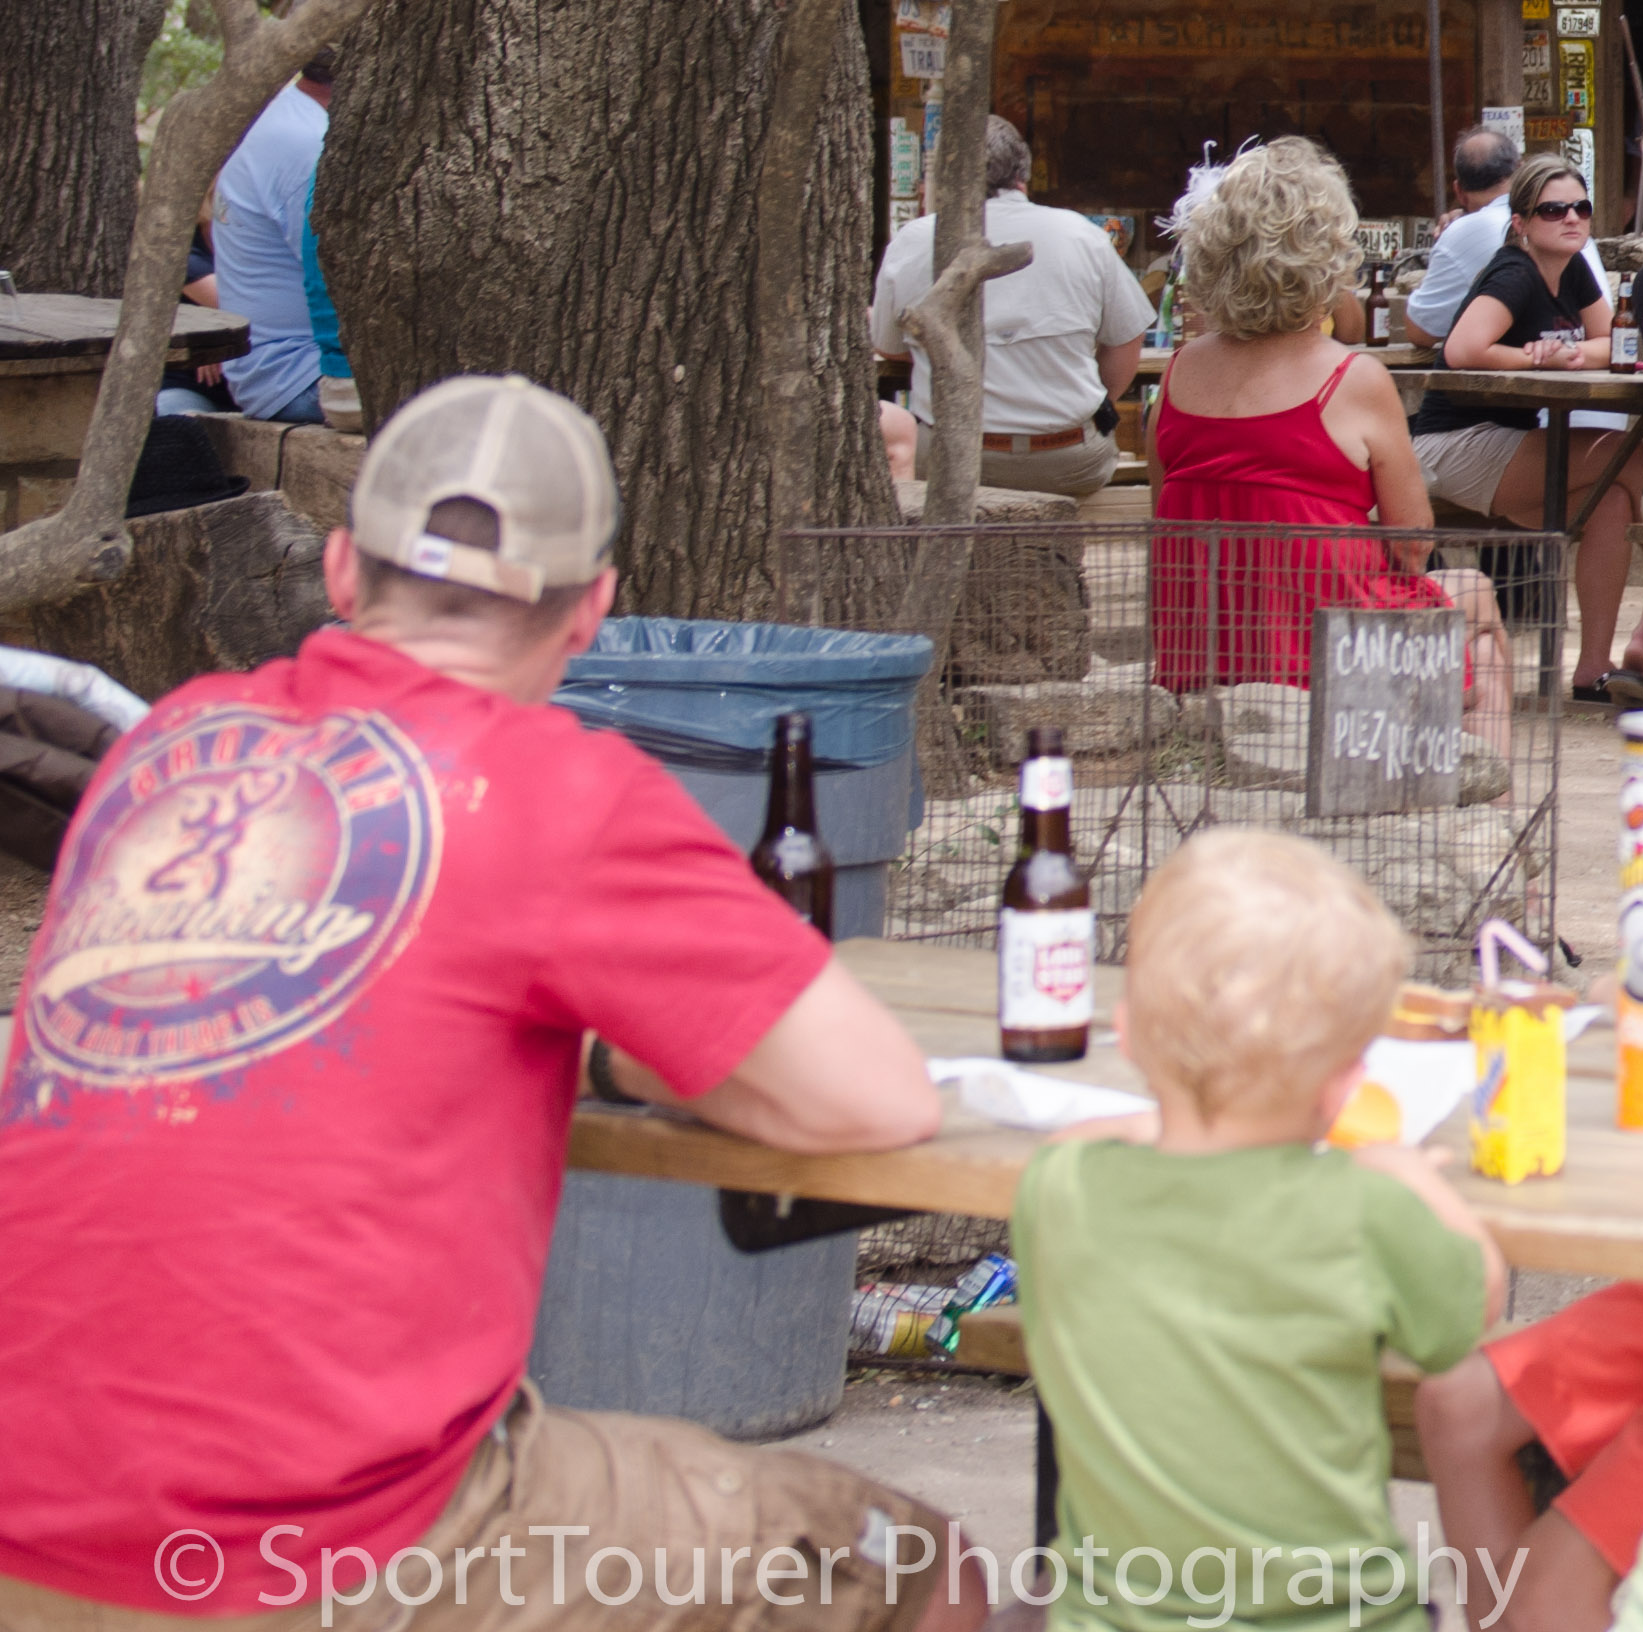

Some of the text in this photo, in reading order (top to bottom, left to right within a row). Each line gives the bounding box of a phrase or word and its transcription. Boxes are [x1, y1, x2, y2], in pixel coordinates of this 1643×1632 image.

[1336, 624, 1461, 680] CAN CORRAL
[1334, 710, 1462, 781] PLEZ RECYCLE
